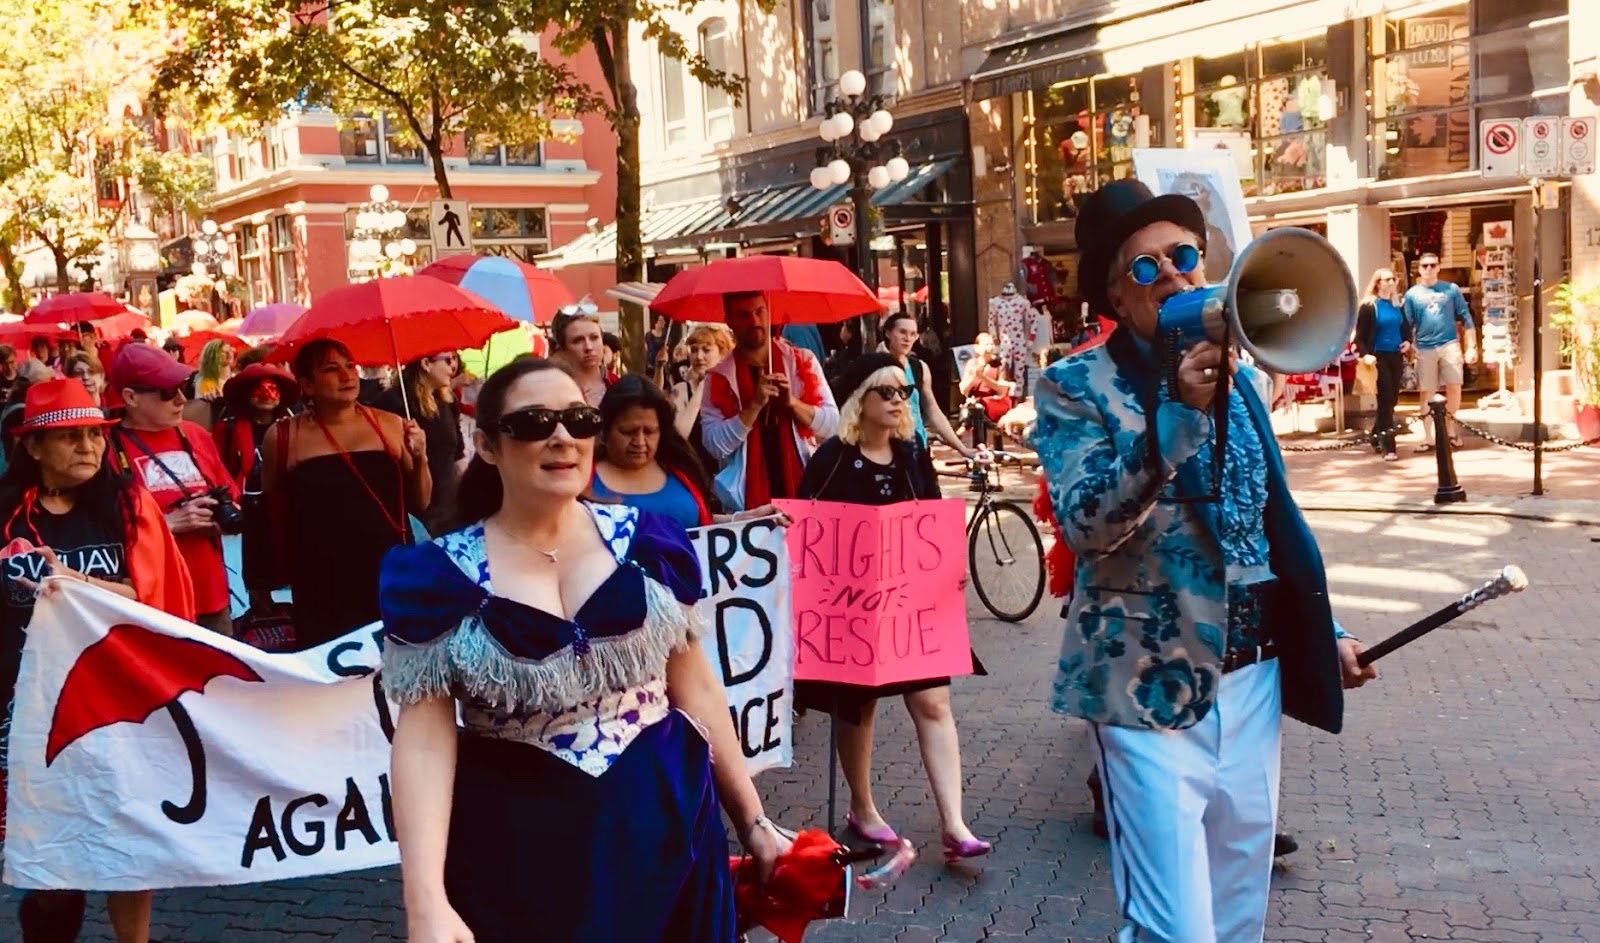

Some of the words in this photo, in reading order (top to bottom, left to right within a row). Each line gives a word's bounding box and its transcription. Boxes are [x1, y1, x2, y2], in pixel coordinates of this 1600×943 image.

[687, 519, 777, 598] RS
[797, 511, 942, 581] RIGHTS
[831, 585, 898, 612] NOT
[797, 604, 941, 667] RESCUE
